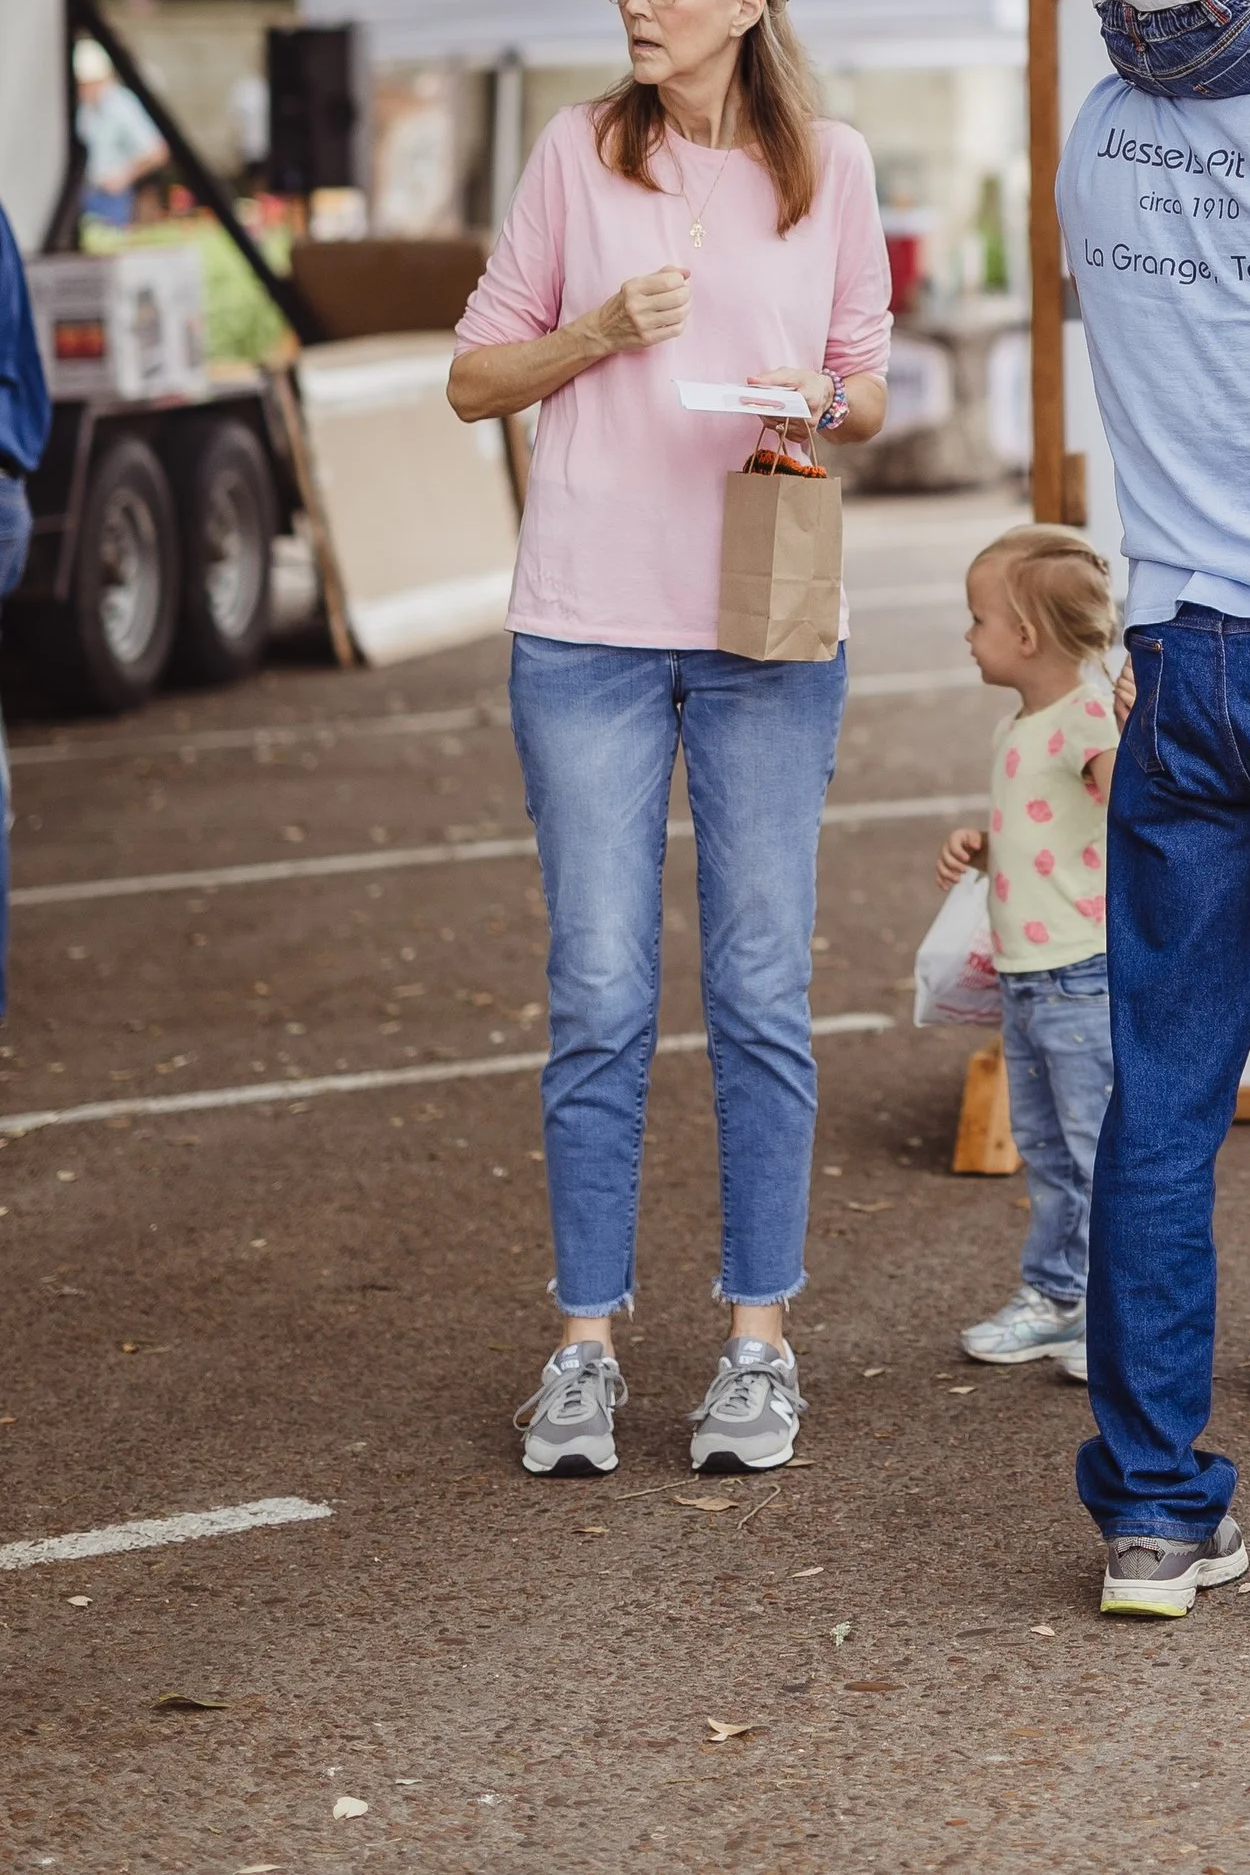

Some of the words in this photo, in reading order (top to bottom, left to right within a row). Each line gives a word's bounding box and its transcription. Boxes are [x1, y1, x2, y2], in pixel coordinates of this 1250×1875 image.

[1097, 128, 1204, 174] Wessels
[1206, 149, 1245, 178] Pit
[1139, 191, 1182, 214] circa
[1193, 197, 1240, 219] 1910
[1085, 238, 1104, 267] La
[1112, 243, 1220, 284] Grange,
